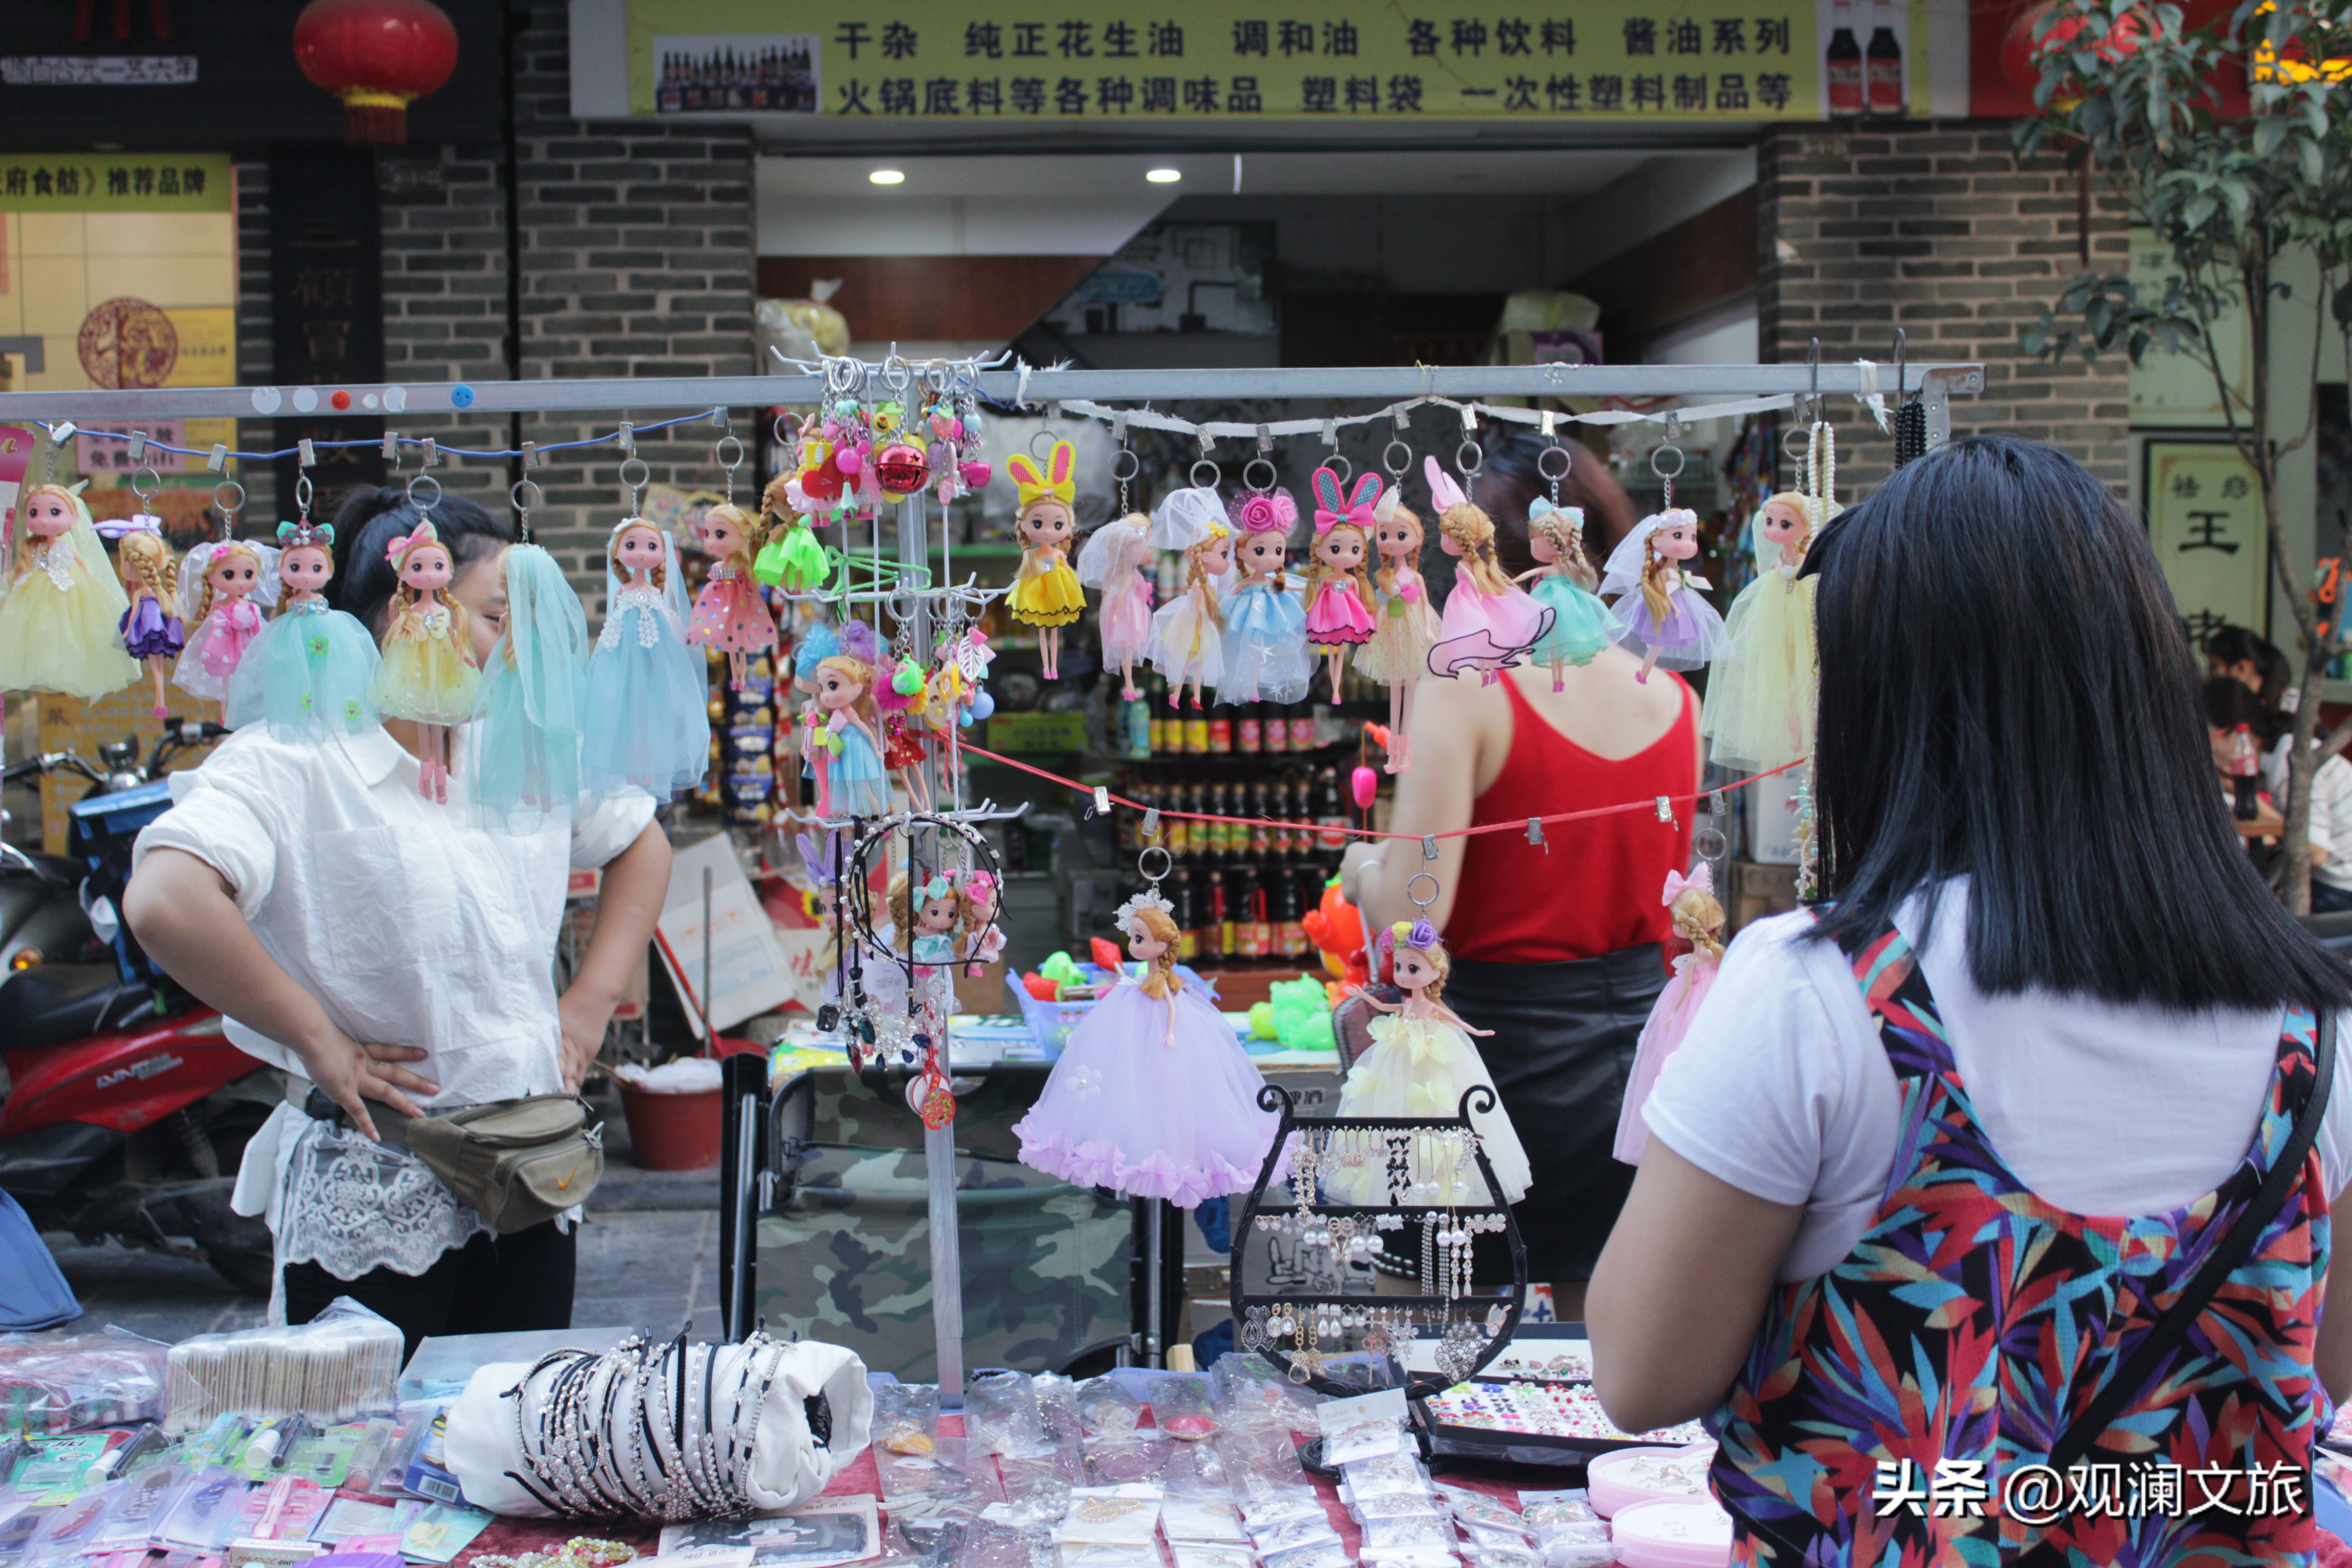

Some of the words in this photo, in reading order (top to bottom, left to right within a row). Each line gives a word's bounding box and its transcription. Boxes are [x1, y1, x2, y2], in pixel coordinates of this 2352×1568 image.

[836, 21, 917, 59] 干杂
[965, 20, 1183, 59] 纯正花生油
[1232, 20, 1357, 57] 调和油
[1407, 19, 1576, 56] 各种饮料
[1623, 18, 1789, 55] 酱油系列
[838, 76, 1263, 115] 火锅底料等各种调味品
[1302, 75, 1422, 113] 塑料袋
[1462, 73, 1790, 111] 一次性塑料制品等
[0, 167, 206, 196] 府食舫》推荐品牌
[1272, 1090, 1323, 1105] 啤酒
[1326, 1409, 1349, 1419] fashion
